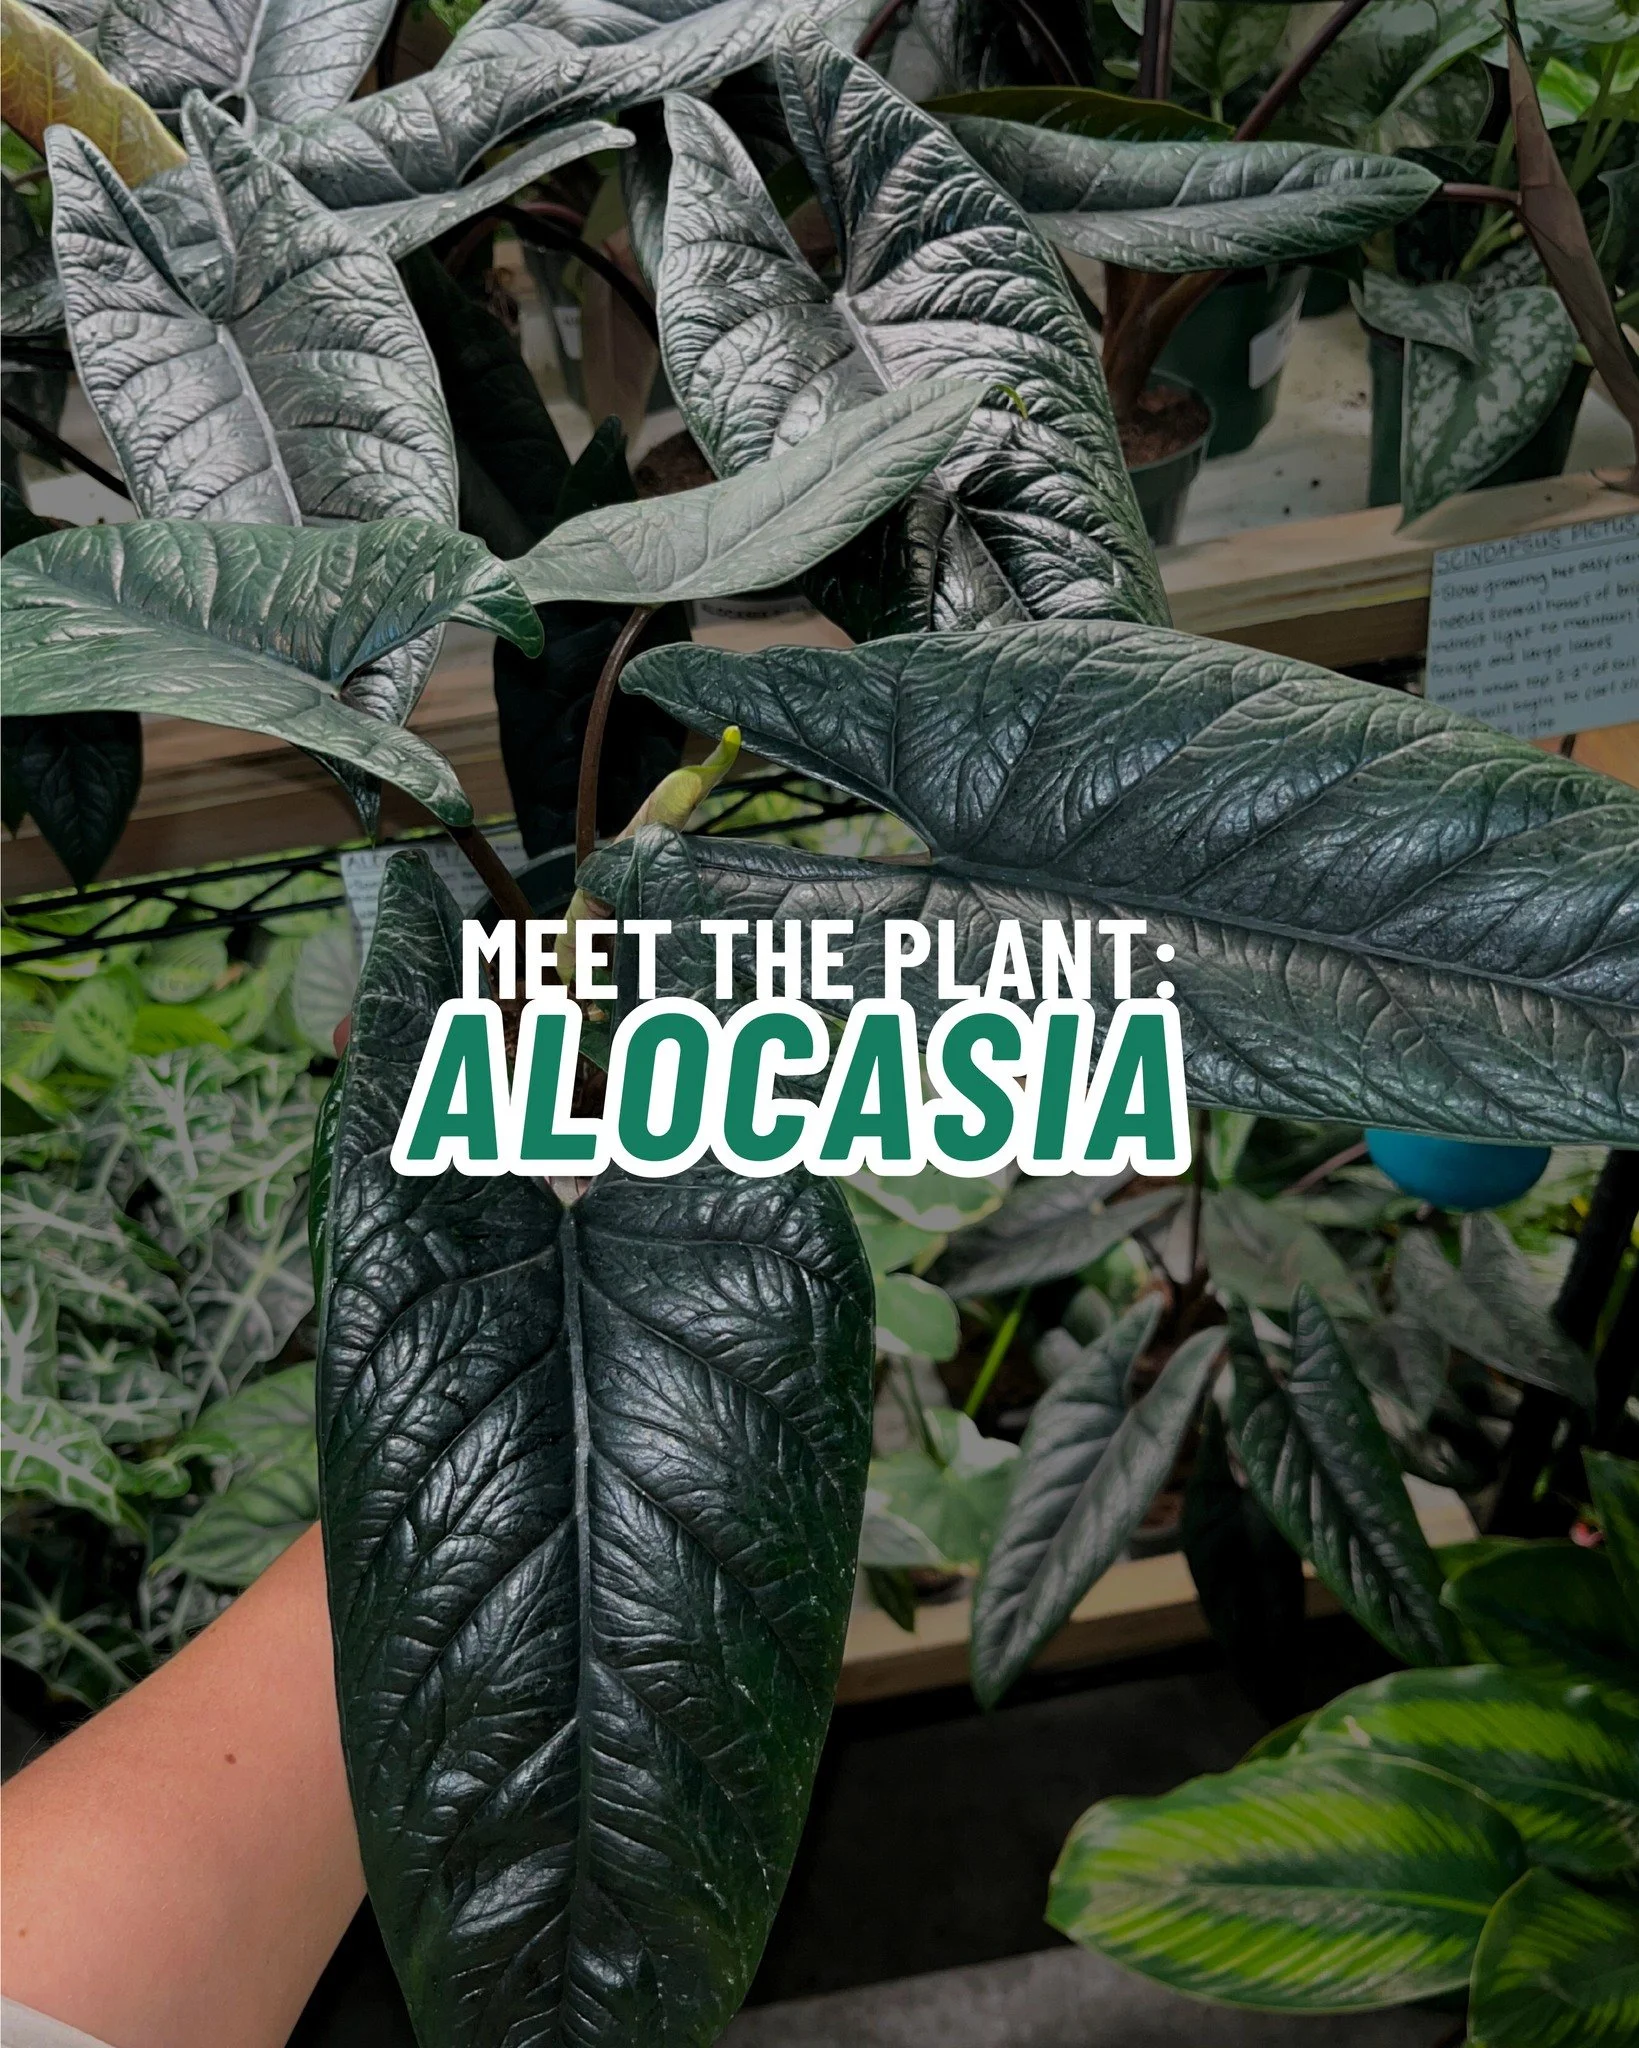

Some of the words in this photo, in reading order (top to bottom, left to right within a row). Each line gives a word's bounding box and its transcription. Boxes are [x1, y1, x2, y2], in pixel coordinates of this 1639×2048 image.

[1437, 529, 1561, 573] SCINDAPSUS
[1571, 514, 1635, 542] PICTUS
[1484, 572, 1549, 602] growing
